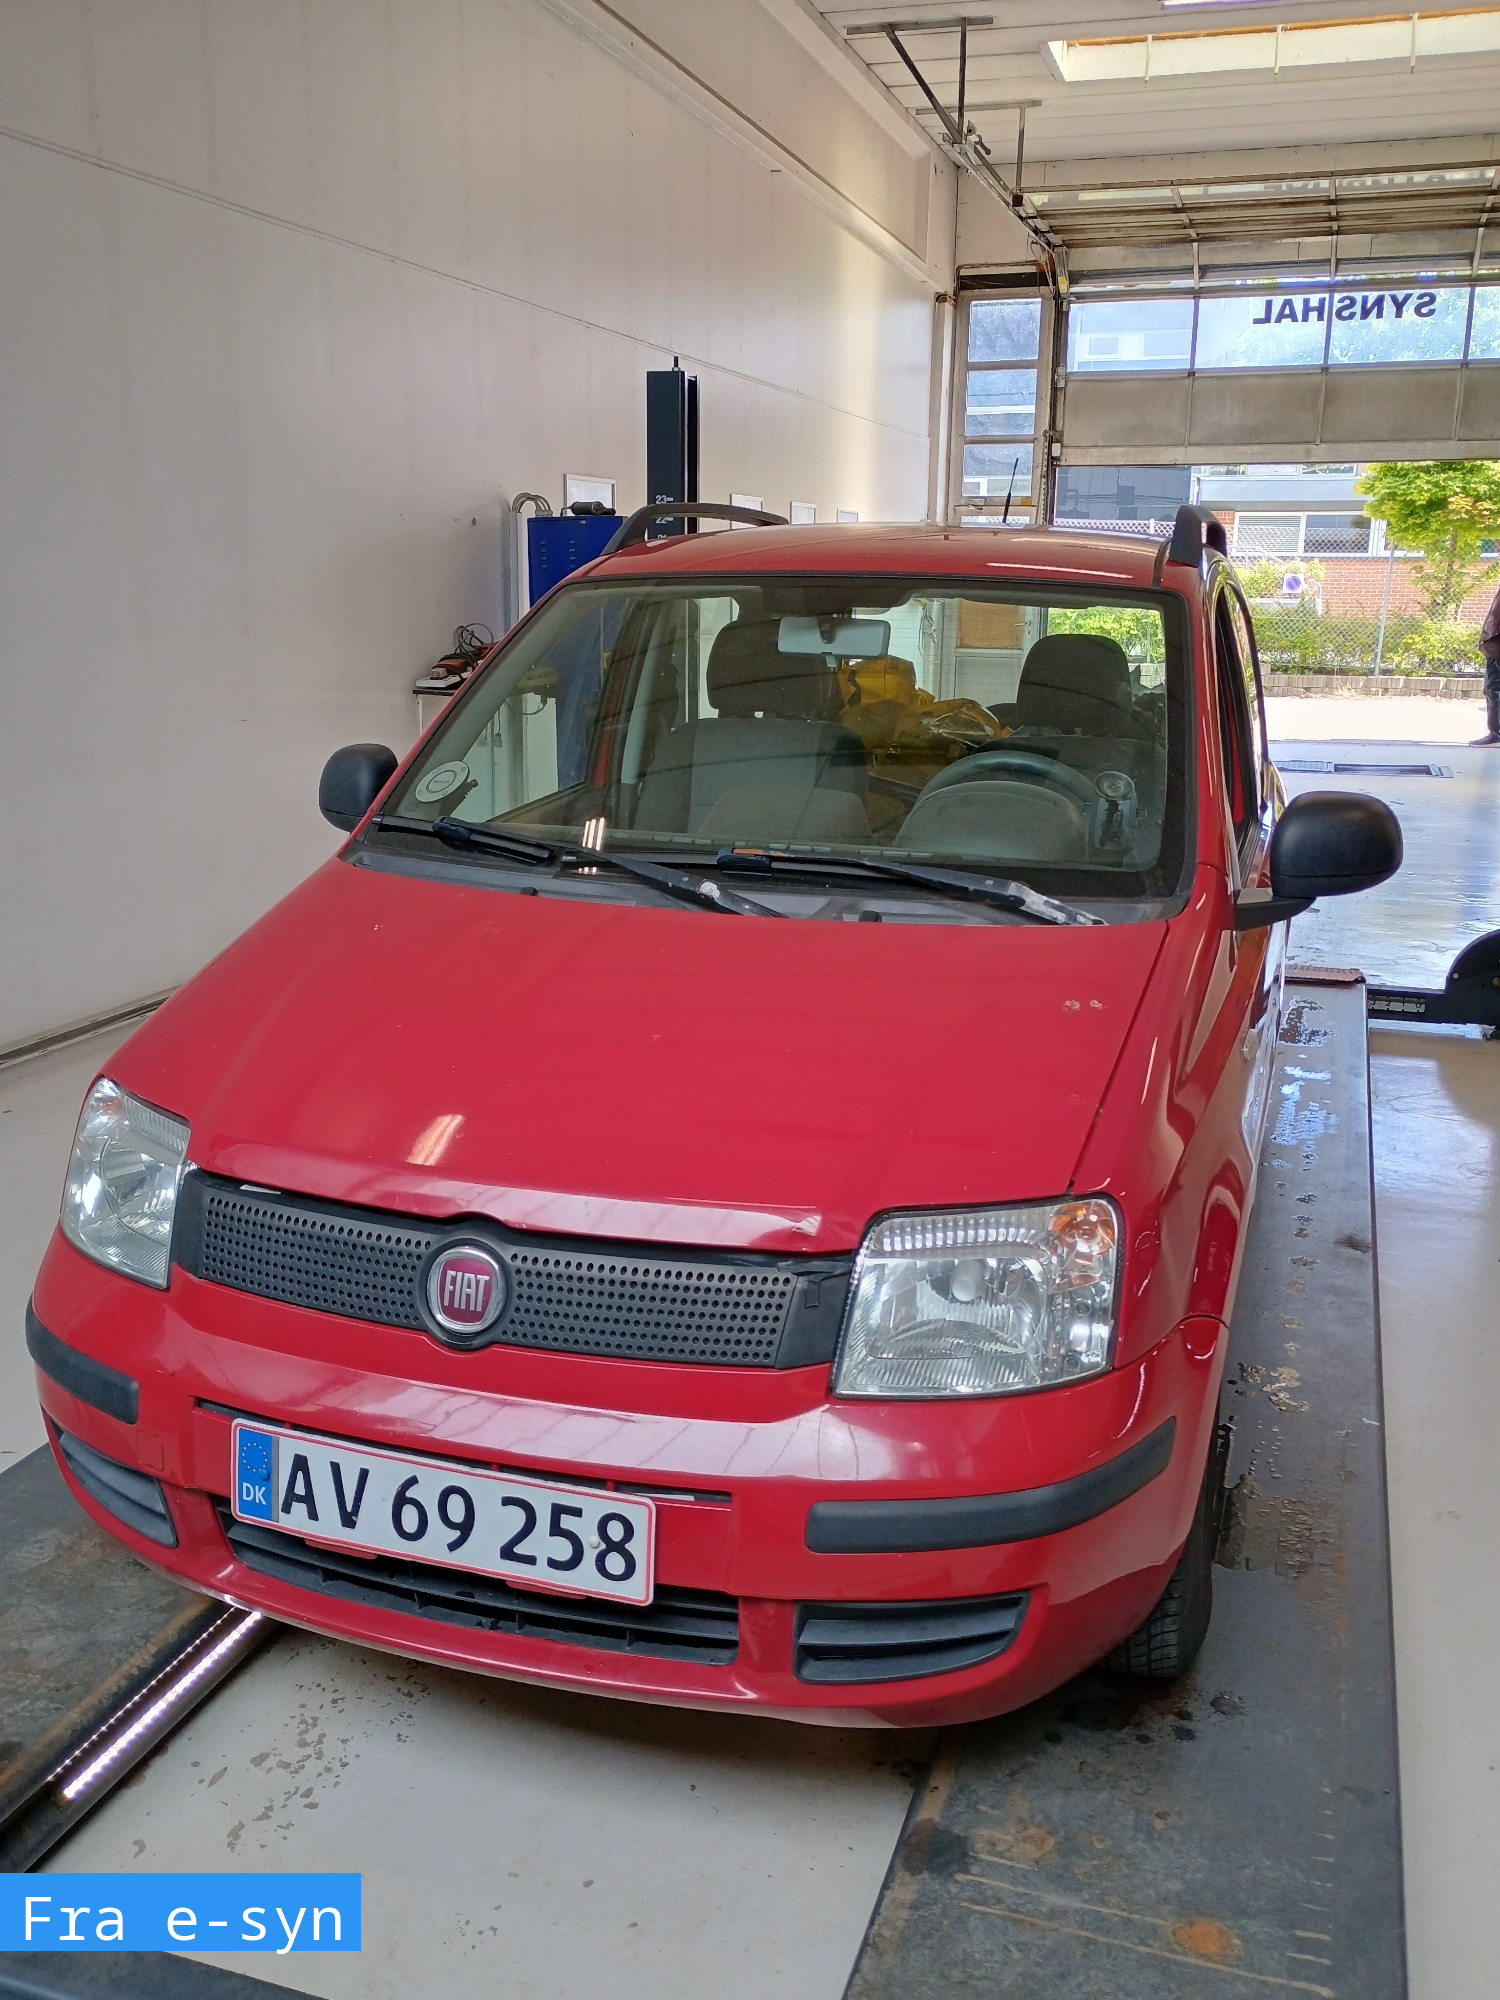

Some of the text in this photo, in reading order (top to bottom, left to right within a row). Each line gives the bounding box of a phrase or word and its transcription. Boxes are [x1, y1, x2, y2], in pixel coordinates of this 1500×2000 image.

[655, 495, 667, 504] 23
[443, 1269, 490, 1312] FIAT
[242, 1482, 267, 1506] DK
[280, 1453, 637, 1583] AV 69 258
